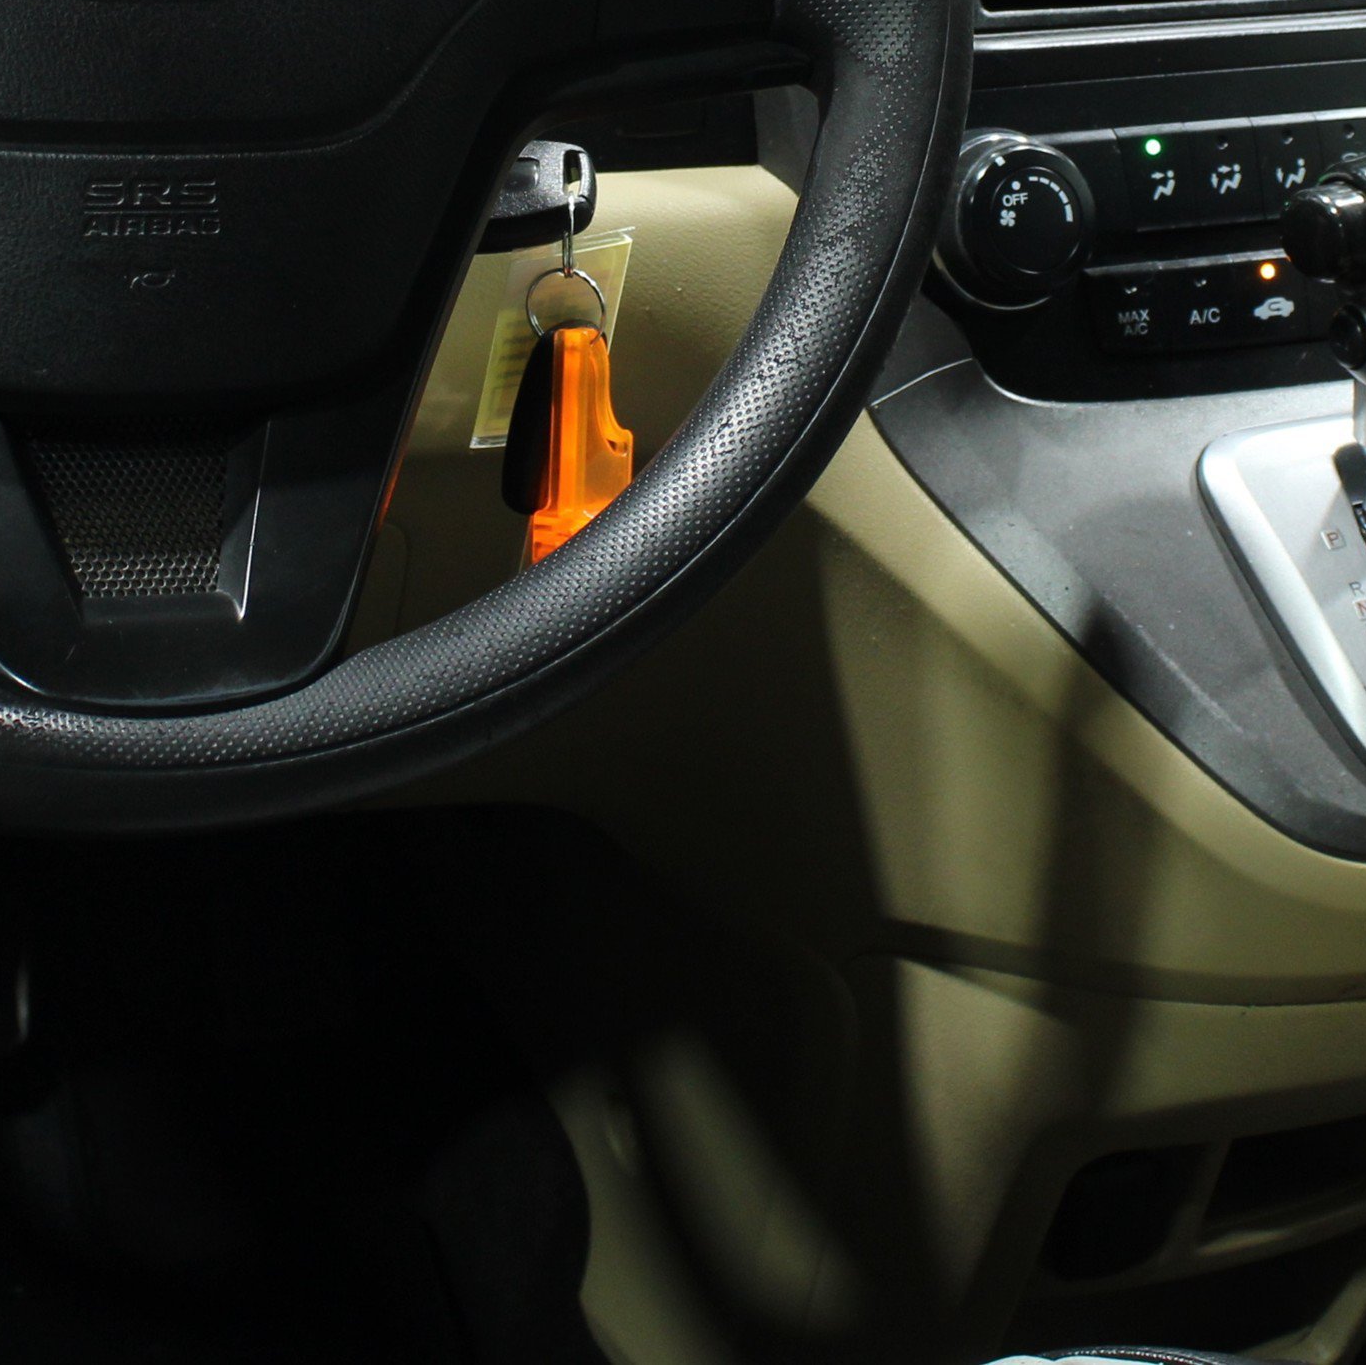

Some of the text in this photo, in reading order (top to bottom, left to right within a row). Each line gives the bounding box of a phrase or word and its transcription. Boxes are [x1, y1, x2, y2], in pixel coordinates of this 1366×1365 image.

[86, 180, 218, 206] SRS
[1002, 192, 1029, 208] OFF
[84, 218, 222, 236] AIRBAG
[1118, 308, 1151, 323] MAX
[1189, 306, 1222, 325] A/C
[1348, 580, 1365, 597] R
